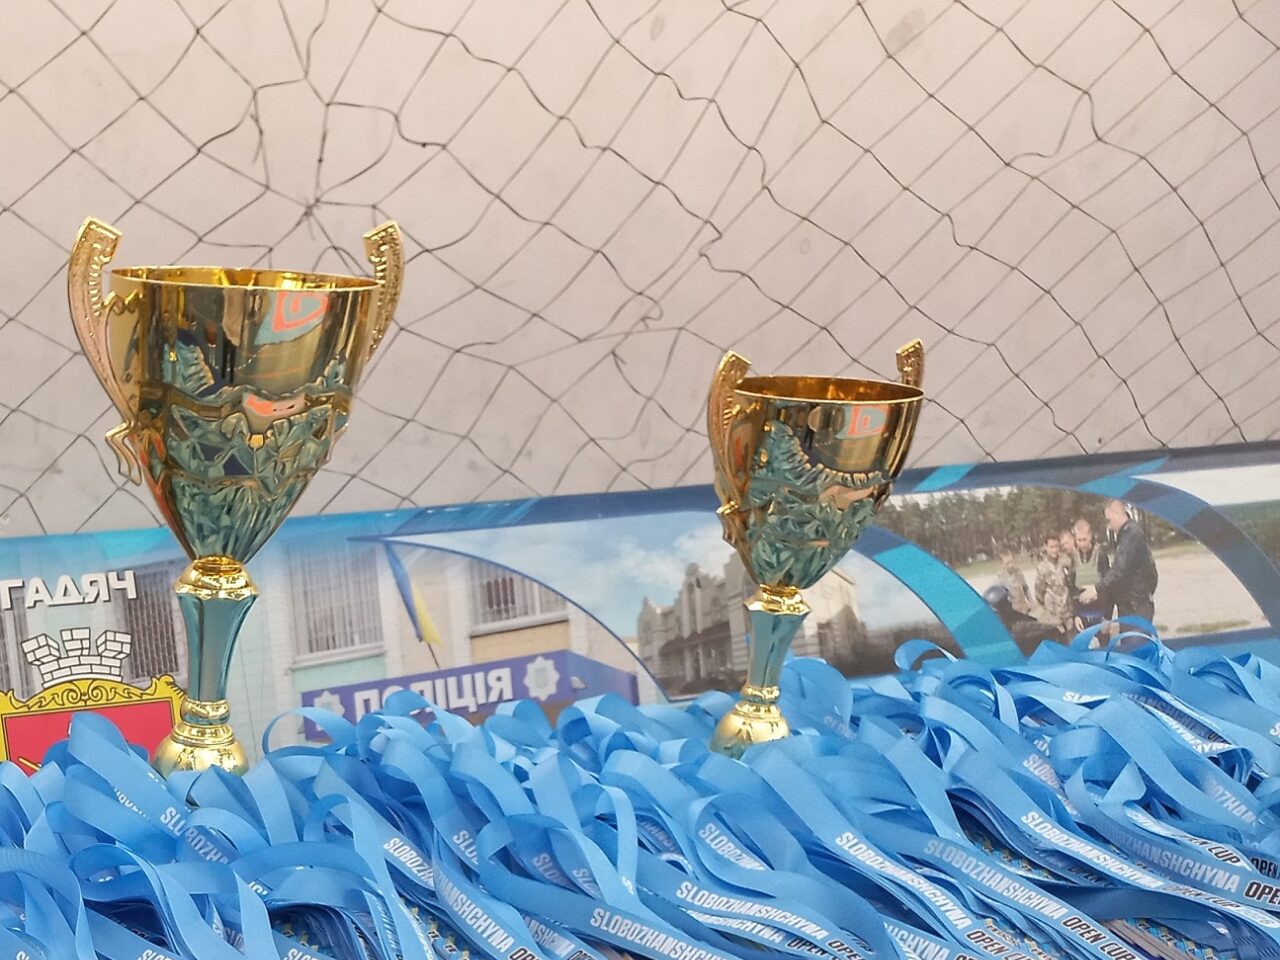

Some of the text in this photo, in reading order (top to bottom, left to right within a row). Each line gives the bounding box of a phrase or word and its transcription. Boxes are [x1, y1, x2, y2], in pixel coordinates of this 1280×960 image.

[0, 570, 137, 610] ГАДЯЧ
[354, 667, 514, 722] ПЛІЦІЯ
[1207, 843, 1241, 864] CUP
[676, 881, 831, 941] SLOBOZHANSHCHYNA
[923, 839, 1069, 920] SLOBOZHANSHCHYNA
[1061, 915, 1106, 944] OPEN
[1244, 880, 1280, 905] OPE
[966, 929, 1010, 956] OPEN
